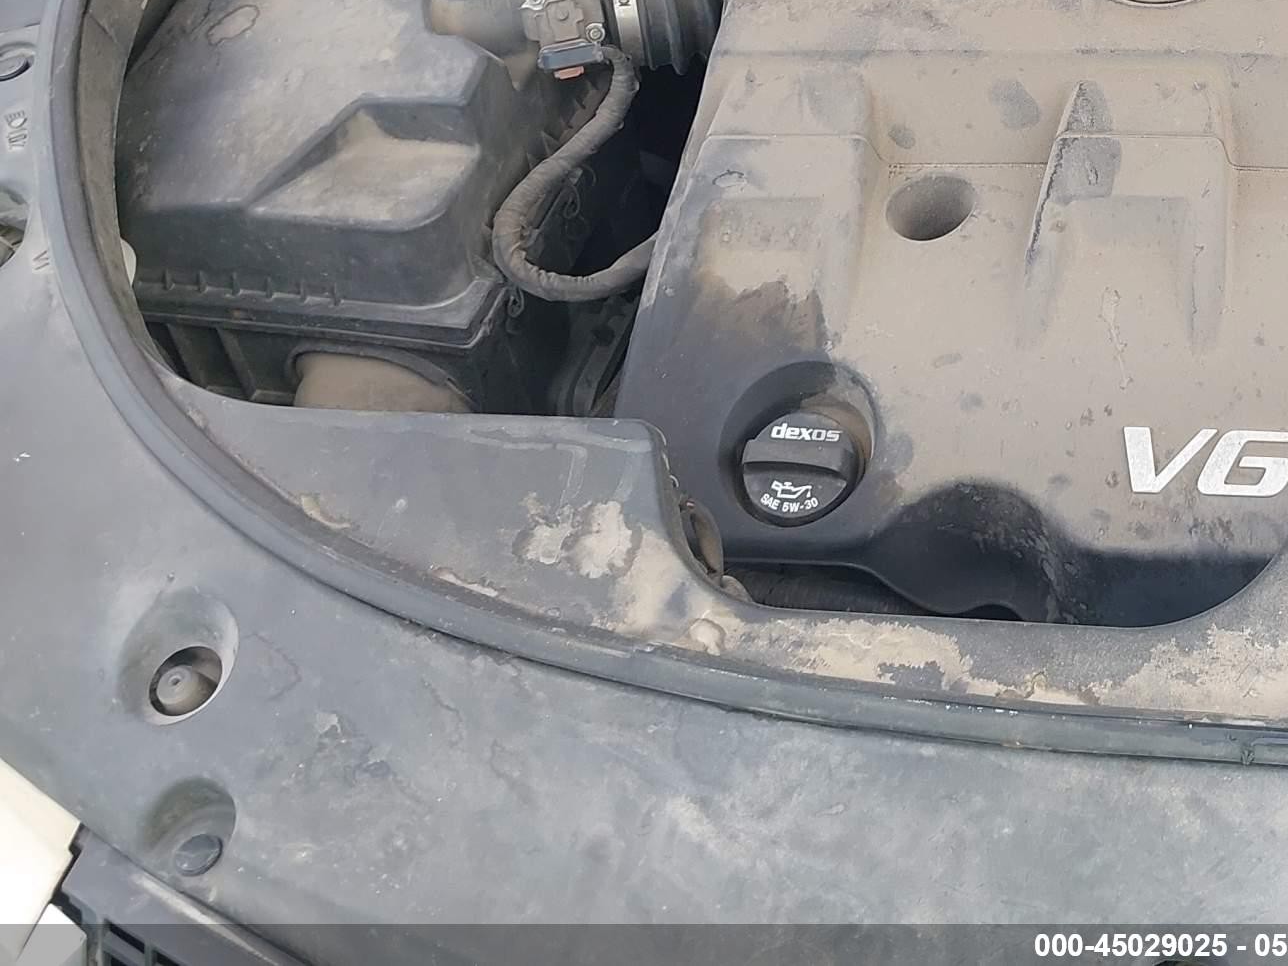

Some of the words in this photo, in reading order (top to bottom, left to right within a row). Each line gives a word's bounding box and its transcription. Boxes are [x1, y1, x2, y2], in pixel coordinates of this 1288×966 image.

[771, 423, 843, 442] dexos
[760, 493, 779, 510] SAE
[782, 497, 819, 513] 5W-30
